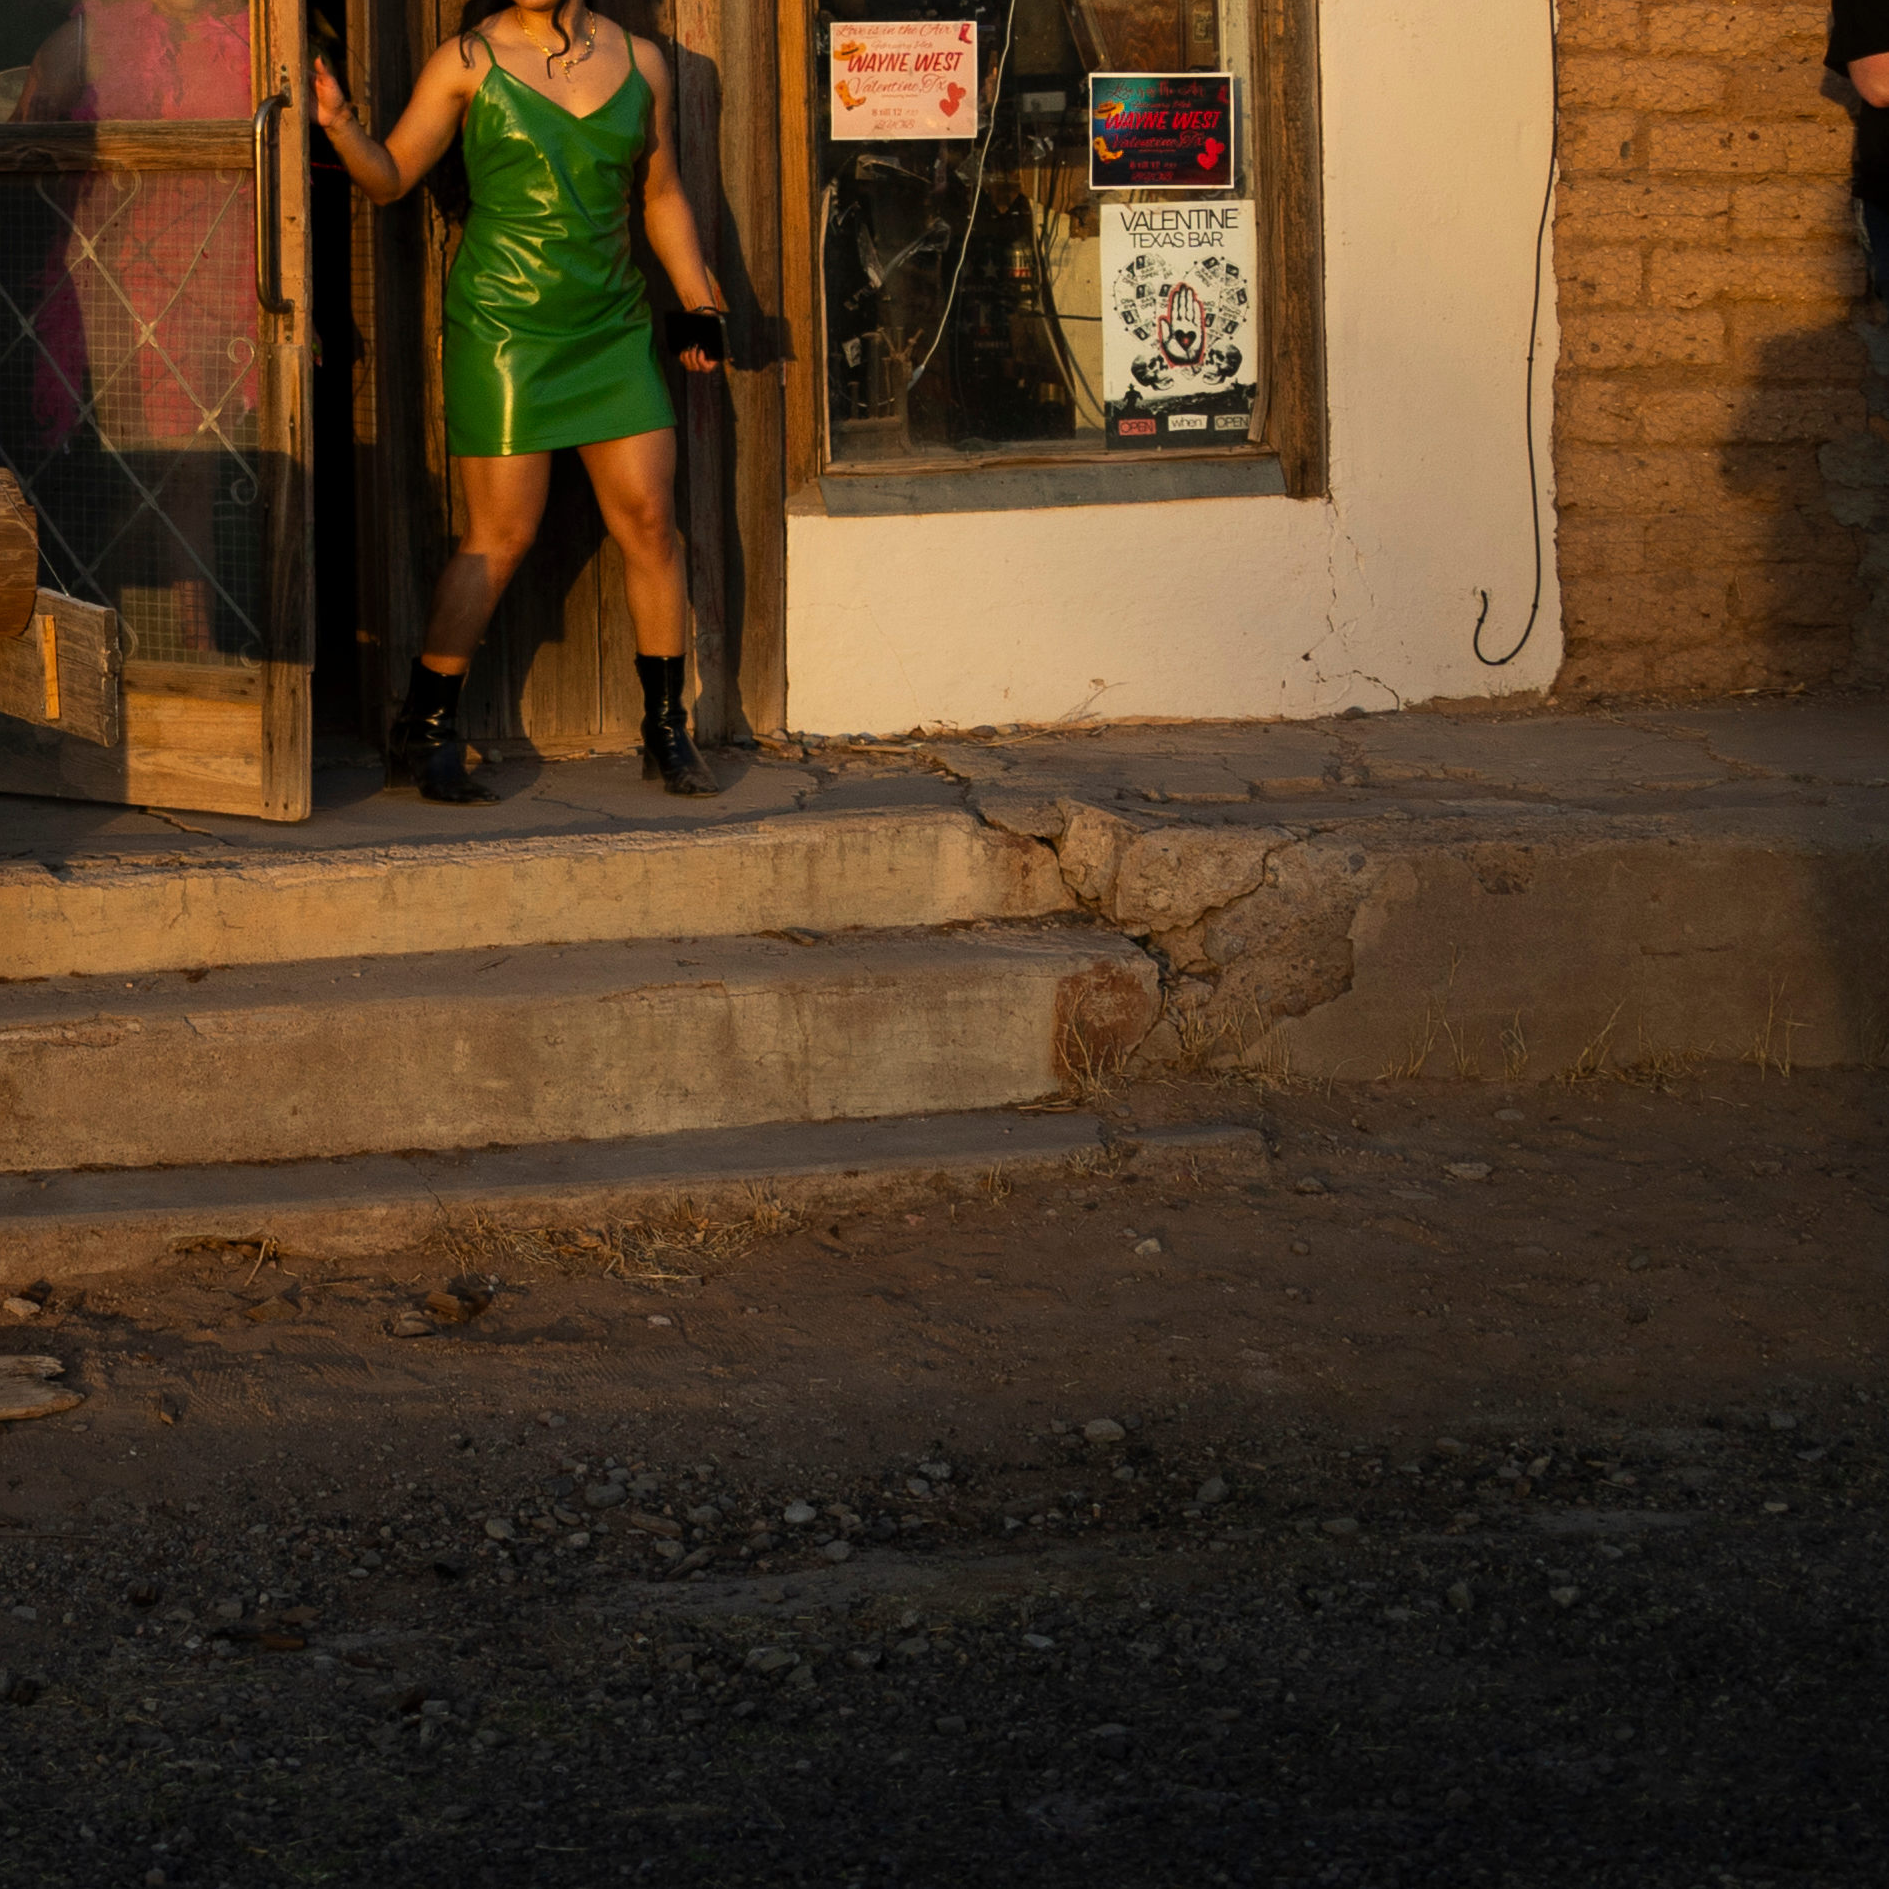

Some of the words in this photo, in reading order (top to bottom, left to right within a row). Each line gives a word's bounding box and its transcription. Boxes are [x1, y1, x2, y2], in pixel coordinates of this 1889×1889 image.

[897, 23, 918, 35] the
[847, 53, 910, 73] WAYNE
[914, 52, 964, 72] WEST
[1105, 111, 1169, 130] WAYNE
[1171, 111, 1222, 129] WEST
[1120, 208, 1239, 232] VALENTINE
[1129, 231, 1185, 249] TEXAS
[1188, 231, 1225, 248] BAR
[1121, 420, 1154, 433] OPEN
[1171, 417, 1203, 428] when
[1216, 416, 1248, 428] OPEN
